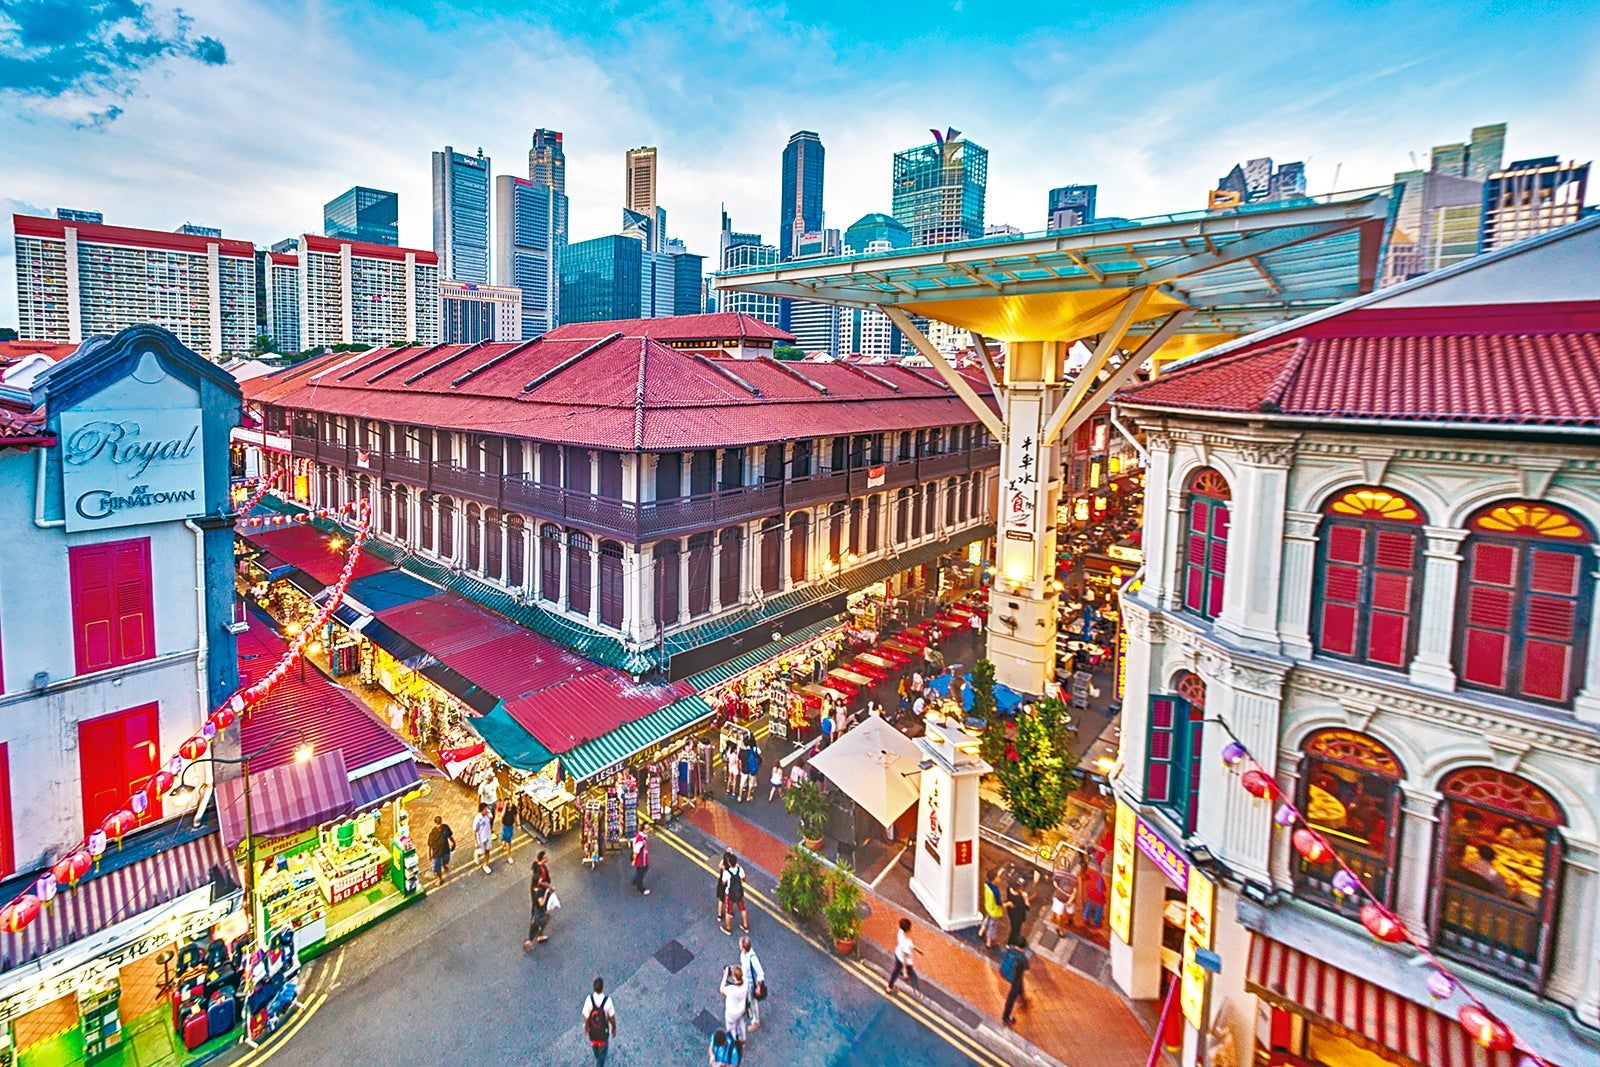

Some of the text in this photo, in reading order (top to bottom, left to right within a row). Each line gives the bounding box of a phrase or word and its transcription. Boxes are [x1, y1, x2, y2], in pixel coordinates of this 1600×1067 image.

[65, 420, 199, 480] Royal
[133, 484, 149, 496] AT
[75, 488, 196, 520] CHINATOWN
[595, 760, 624, 783] LESLIE
